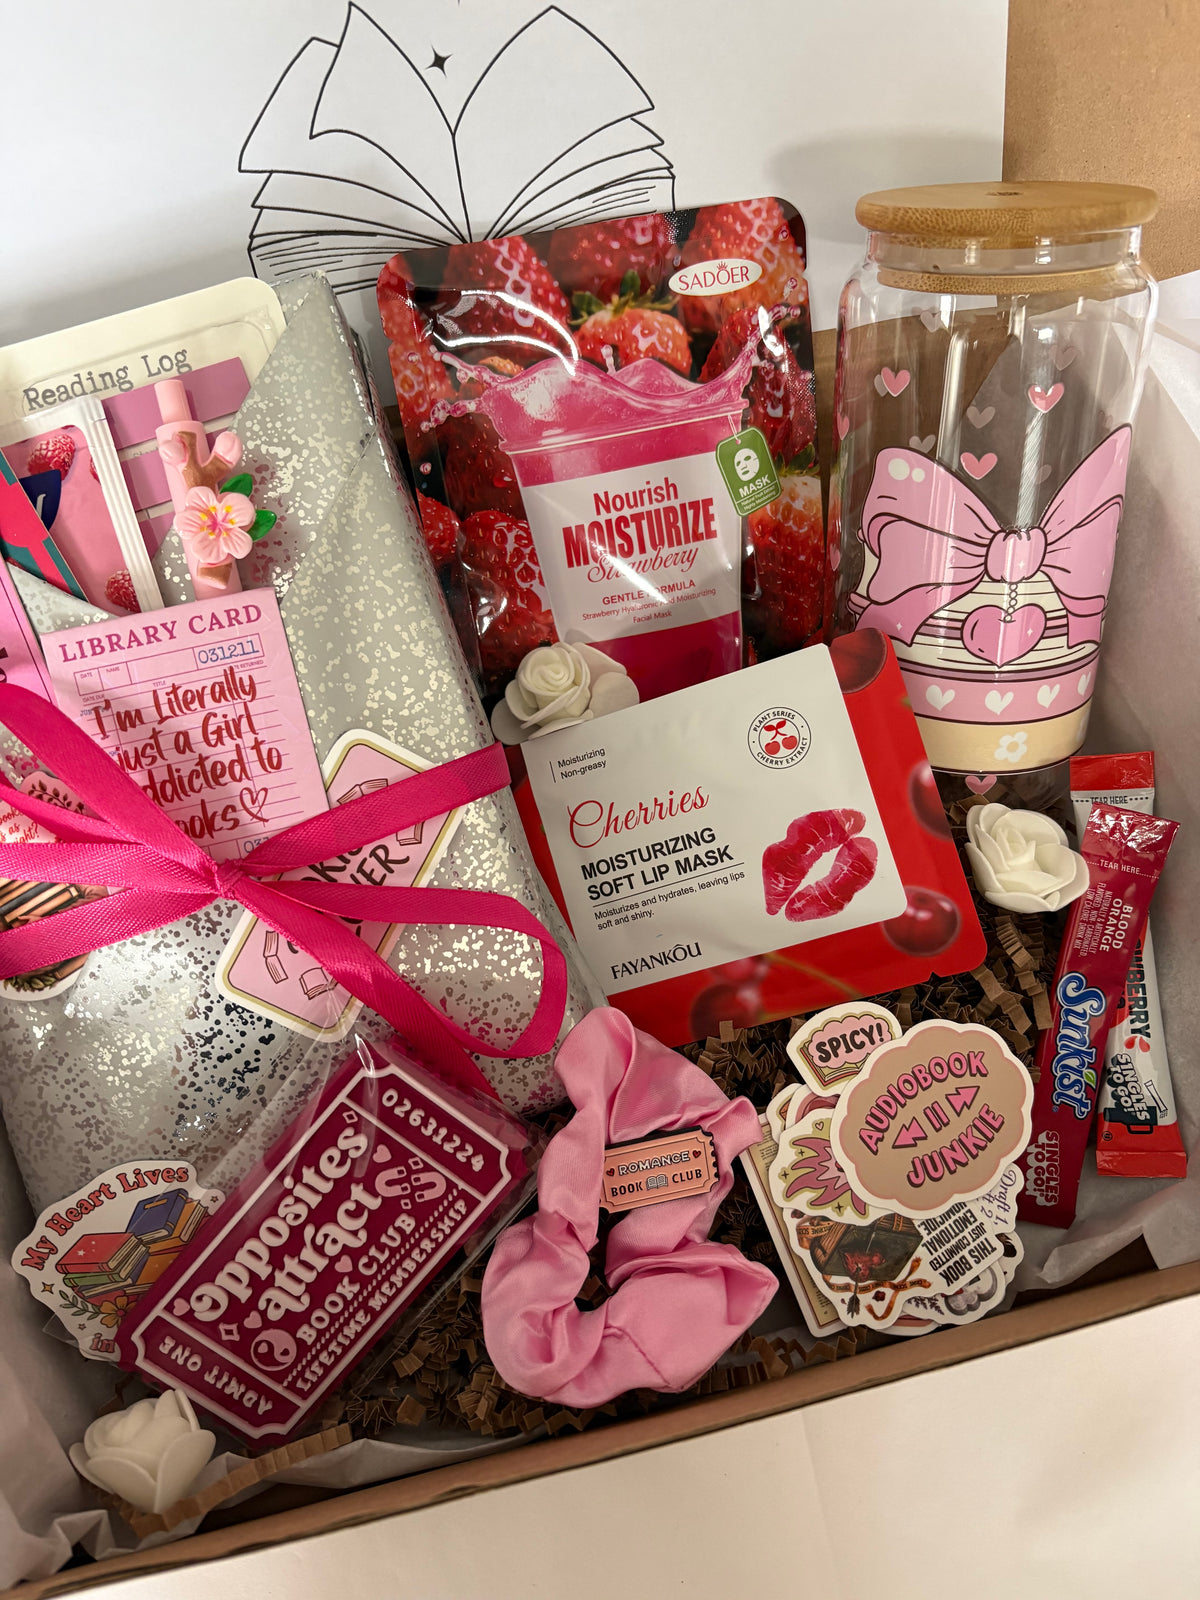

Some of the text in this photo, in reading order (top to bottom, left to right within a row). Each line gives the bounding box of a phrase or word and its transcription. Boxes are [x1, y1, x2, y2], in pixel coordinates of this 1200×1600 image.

[23, 349, 192, 412] Reading Log
[593, 477, 678, 516] Nourish
[739, 475, 771, 497] MASK
[562, 498, 718, 569] MOISTURIZE
[582, 609, 620, 621] Strawberry
[676, 588, 716, 604] Moisturizing
[602, 579, 696, 606] GENTLE RMULA
[633, 610, 672, 624] Facial Mask
[59, 604, 262, 662] LIBRARY CARD
[198, 639, 259, 664] 031211
[80, 671, 93, 680] DATE
[91, 666, 257, 740] I'm Literally
[753, 711, 796, 732] PLANT SERIES
[115, 702, 258, 774] just a Girl
[557, 747, 606, 769] Moisturizing
[757, 737, 808, 766] CHERRY EXTRACT
[142, 737, 282, 807] ddicted to
[560, 760, 607, 781] Non-greasy
[175, 799, 240, 839] ooks
[567, 786, 710, 848] Cherries
[1110, 795, 1129, 804] HERE
[580, 827, 717, 880] MOISTURIZING
[587, 844, 734, 901] SOFT LIP MASK
[1100, 859, 1140, 875] TEAR HERE
[594, 870, 746, 921] Moisturizes and hydrates, leaving lips
[597, 909, 655, 930] soft and shiny.
[1073, 888, 1096, 949] LOW CALORIE DRINK MIX
[1099, 890, 1112, 918] NATURALLY
[1089, 923, 1104, 954] ARTIFICIALLY
[1099, 898, 1122, 952] ORANGE
[1112, 905, 1133, 949] BLOOD
[610, 941, 703, 980] FAYANKÔU
[815, 1022, 885, 1064] SPICY!
[1054, 972, 1106, 1120] Sunkist
[859, 1051, 988, 1154] AUDIOBOOK
[1110, 1066, 1134, 1112] TO GO!
[1115, 1053, 1151, 1120] SINGLES
[381, 1088, 485, 1173] 02631224
[907, 1104, 1004, 1187] JUNKIE
[610, 1169, 702, 1197] BOOK CLUB
[618, 1151, 690, 1176] ROMANCE
[1032, 1143, 1046, 1193] TO GO!
[1044, 1130, 1060, 1204] SINGLES
[994, 1169, 1017, 1213] Draft
[21, 1167, 189, 1271] My Heart Lives
[190, 1126, 368, 1322] Opposites
[921, 1208, 978, 1256] EMOTIONAL
[258, 1183, 382, 1322] attract
[929, 1221, 987, 1272] JUST COMMITTED
[939, 1237, 997, 1287] THIS BOOK
[296, 1213, 416, 1345] BOOK CLUB
[296, 1199, 468, 1392] LIFETIME MEMBERSHIP
[91, 1333, 115, 1353] in
[159, 1335, 274, 1416] ADMIT ONE
